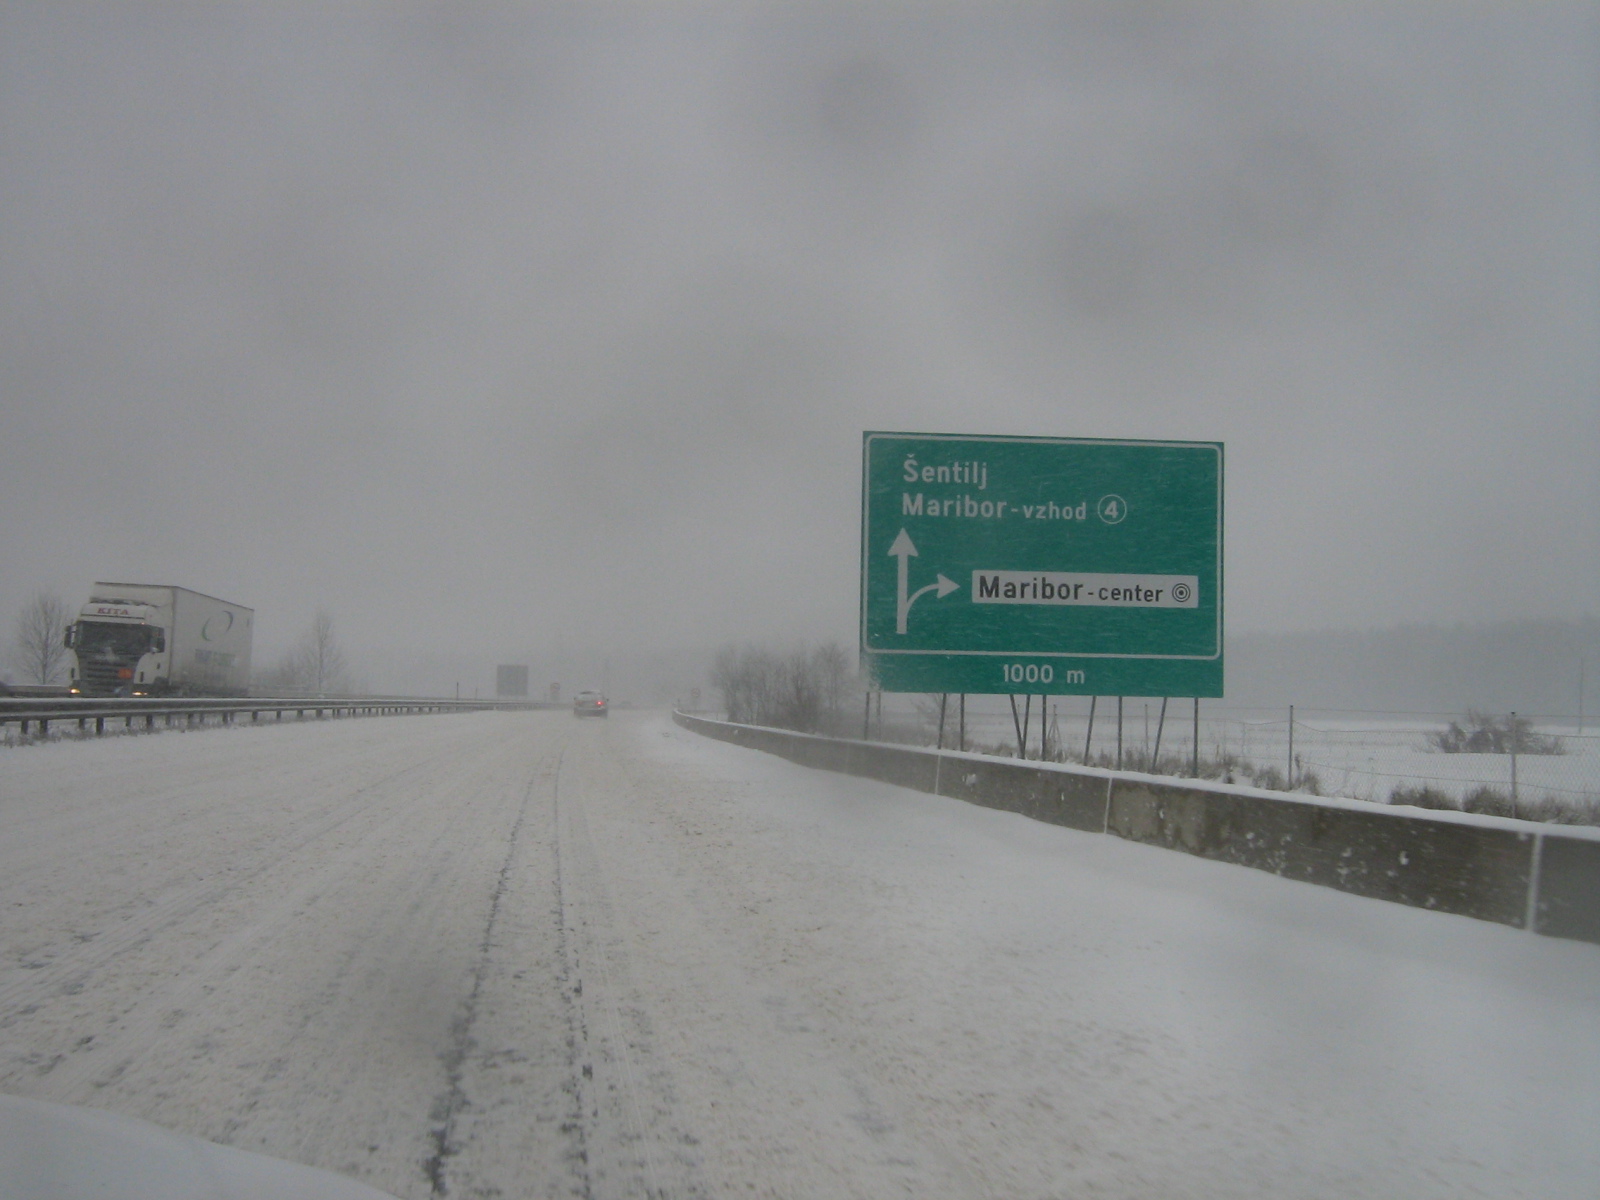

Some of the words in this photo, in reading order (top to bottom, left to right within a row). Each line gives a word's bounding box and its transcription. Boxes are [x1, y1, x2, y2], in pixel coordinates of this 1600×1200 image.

[903, 454, 987, 490] Šentilj
[1104, 500, 1119, 518] 4
[1003, 664, 1053, 684] 1000
[1067, 670, 1085, 684] m
